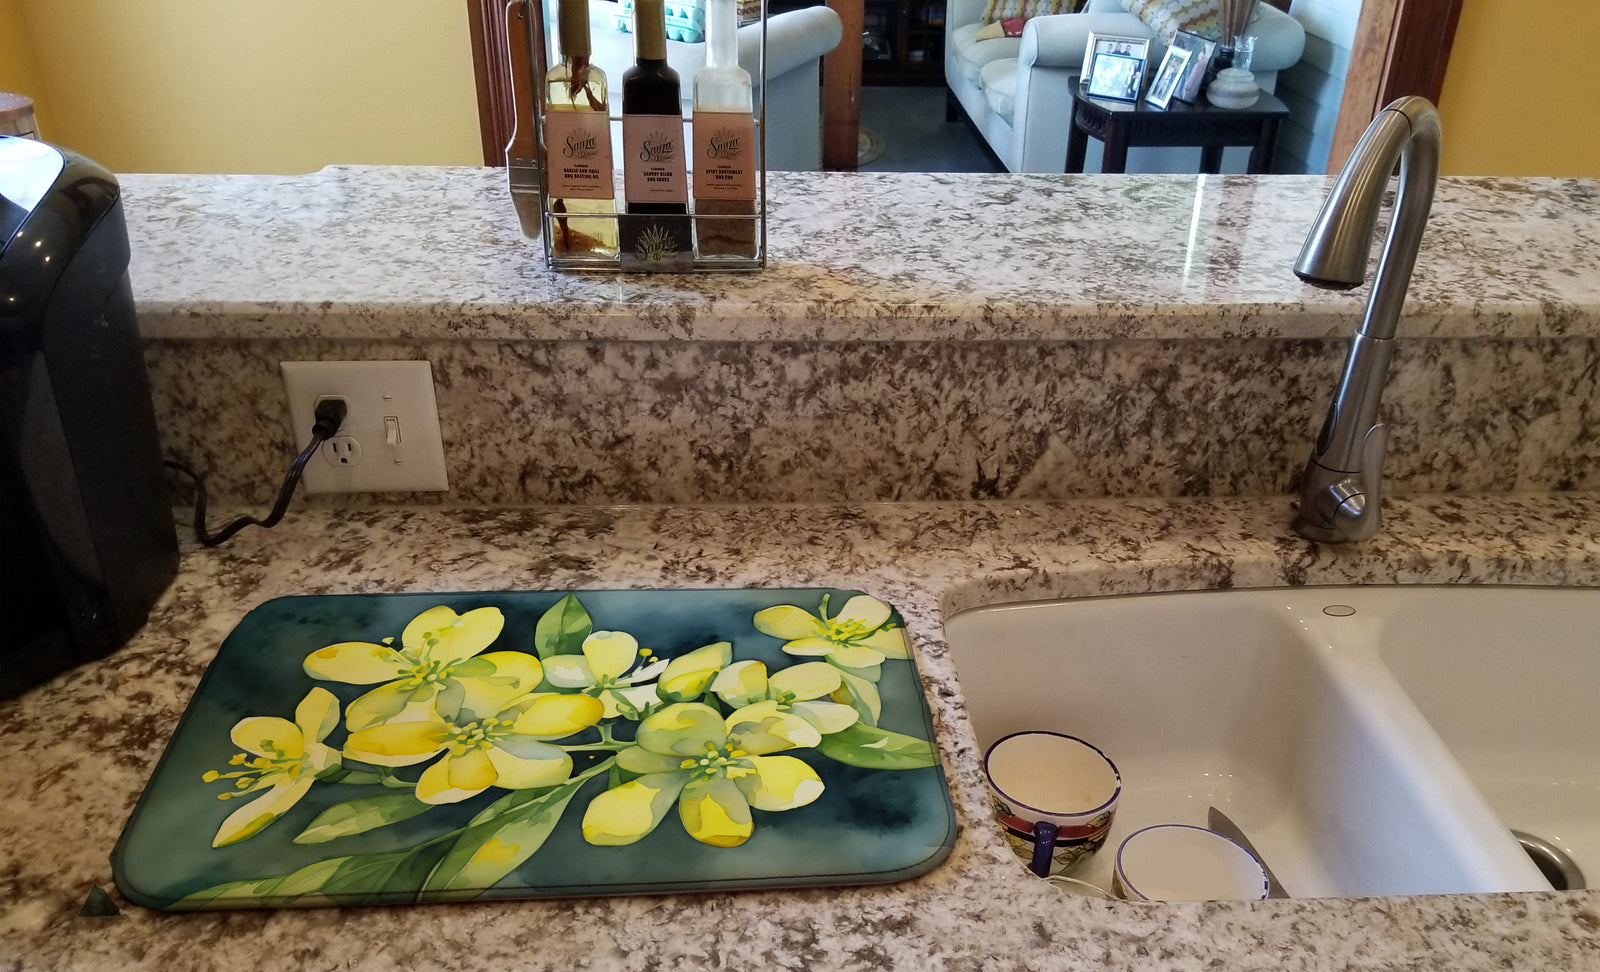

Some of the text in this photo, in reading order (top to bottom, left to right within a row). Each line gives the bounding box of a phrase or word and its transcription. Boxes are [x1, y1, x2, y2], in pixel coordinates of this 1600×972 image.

[563, 136, 597, 158] Sauza
[640, 140, 673, 162] Sauza
[707, 136, 740, 159] Sauza
